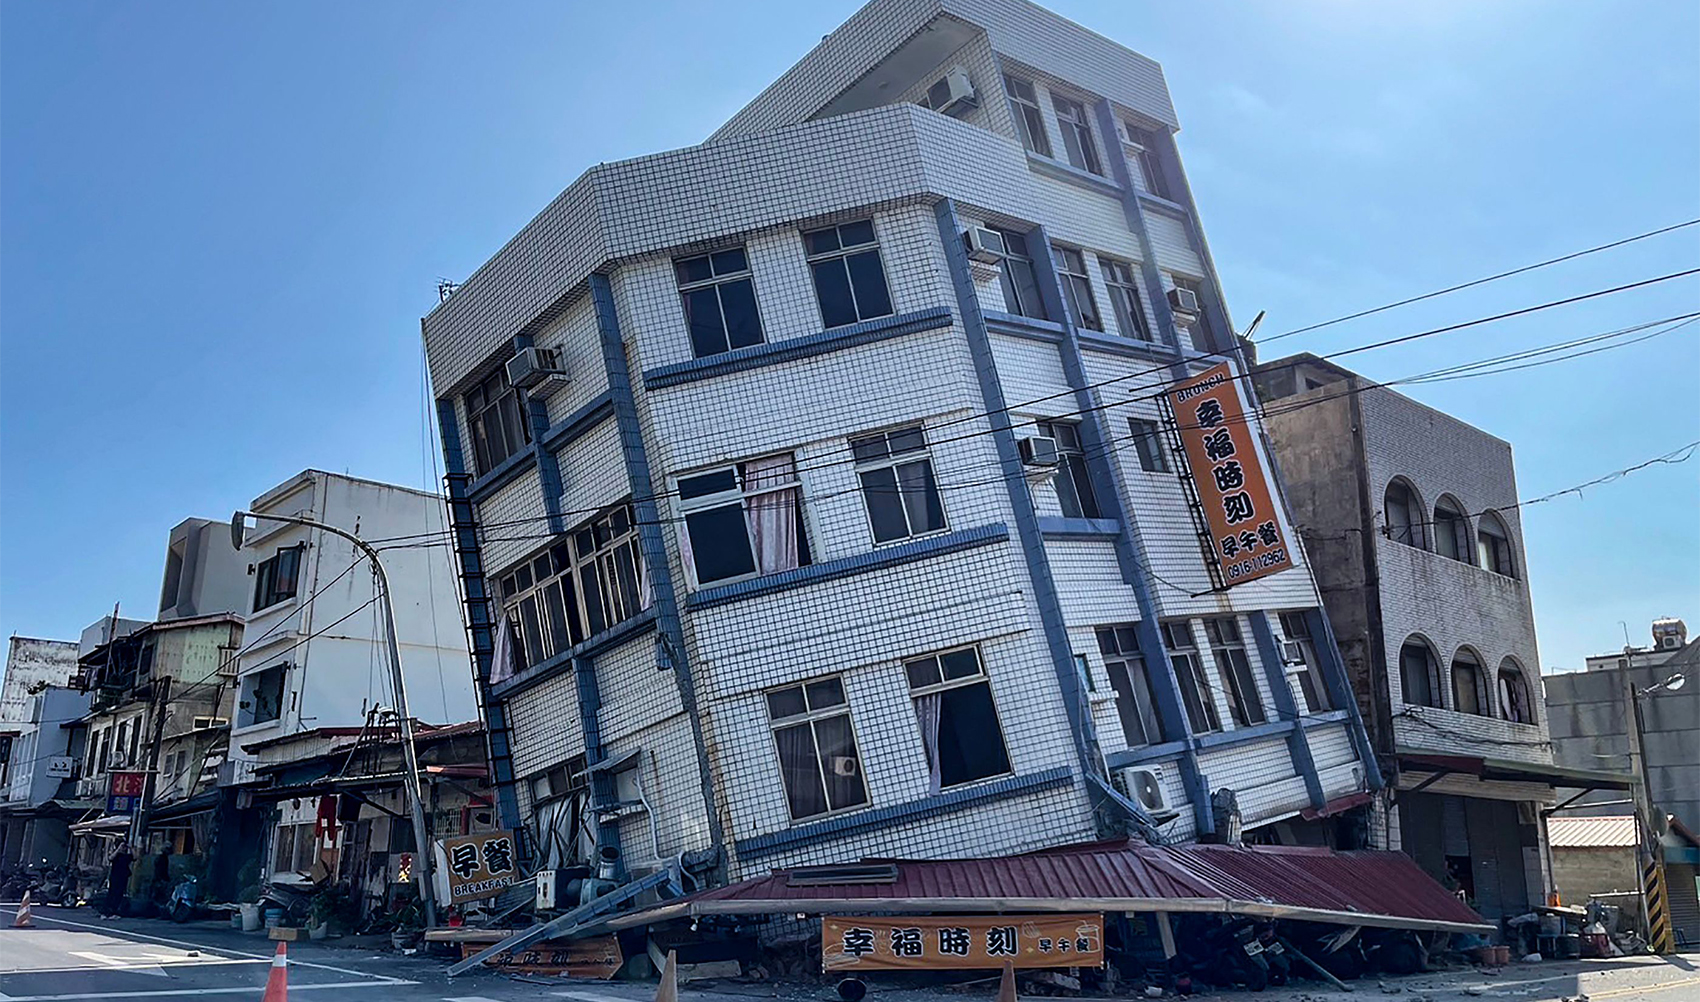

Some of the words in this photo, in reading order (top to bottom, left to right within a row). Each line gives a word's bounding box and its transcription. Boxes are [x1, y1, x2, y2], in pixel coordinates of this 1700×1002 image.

[1177, 373, 1226, 402] BRUNCH
[1194, 398, 1255, 525] 幸福時刻
[1220, 520, 1280, 559] 早午餐
[1227, 548, 1286, 579] 0916-112962
[451, 838, 513, 879] 早餐
[454, 876, 515, 896] BREAKFAST
[842, 926, 1019, 957] 幸福時刻
[1038, 937, 1090, 953] 早午餐
